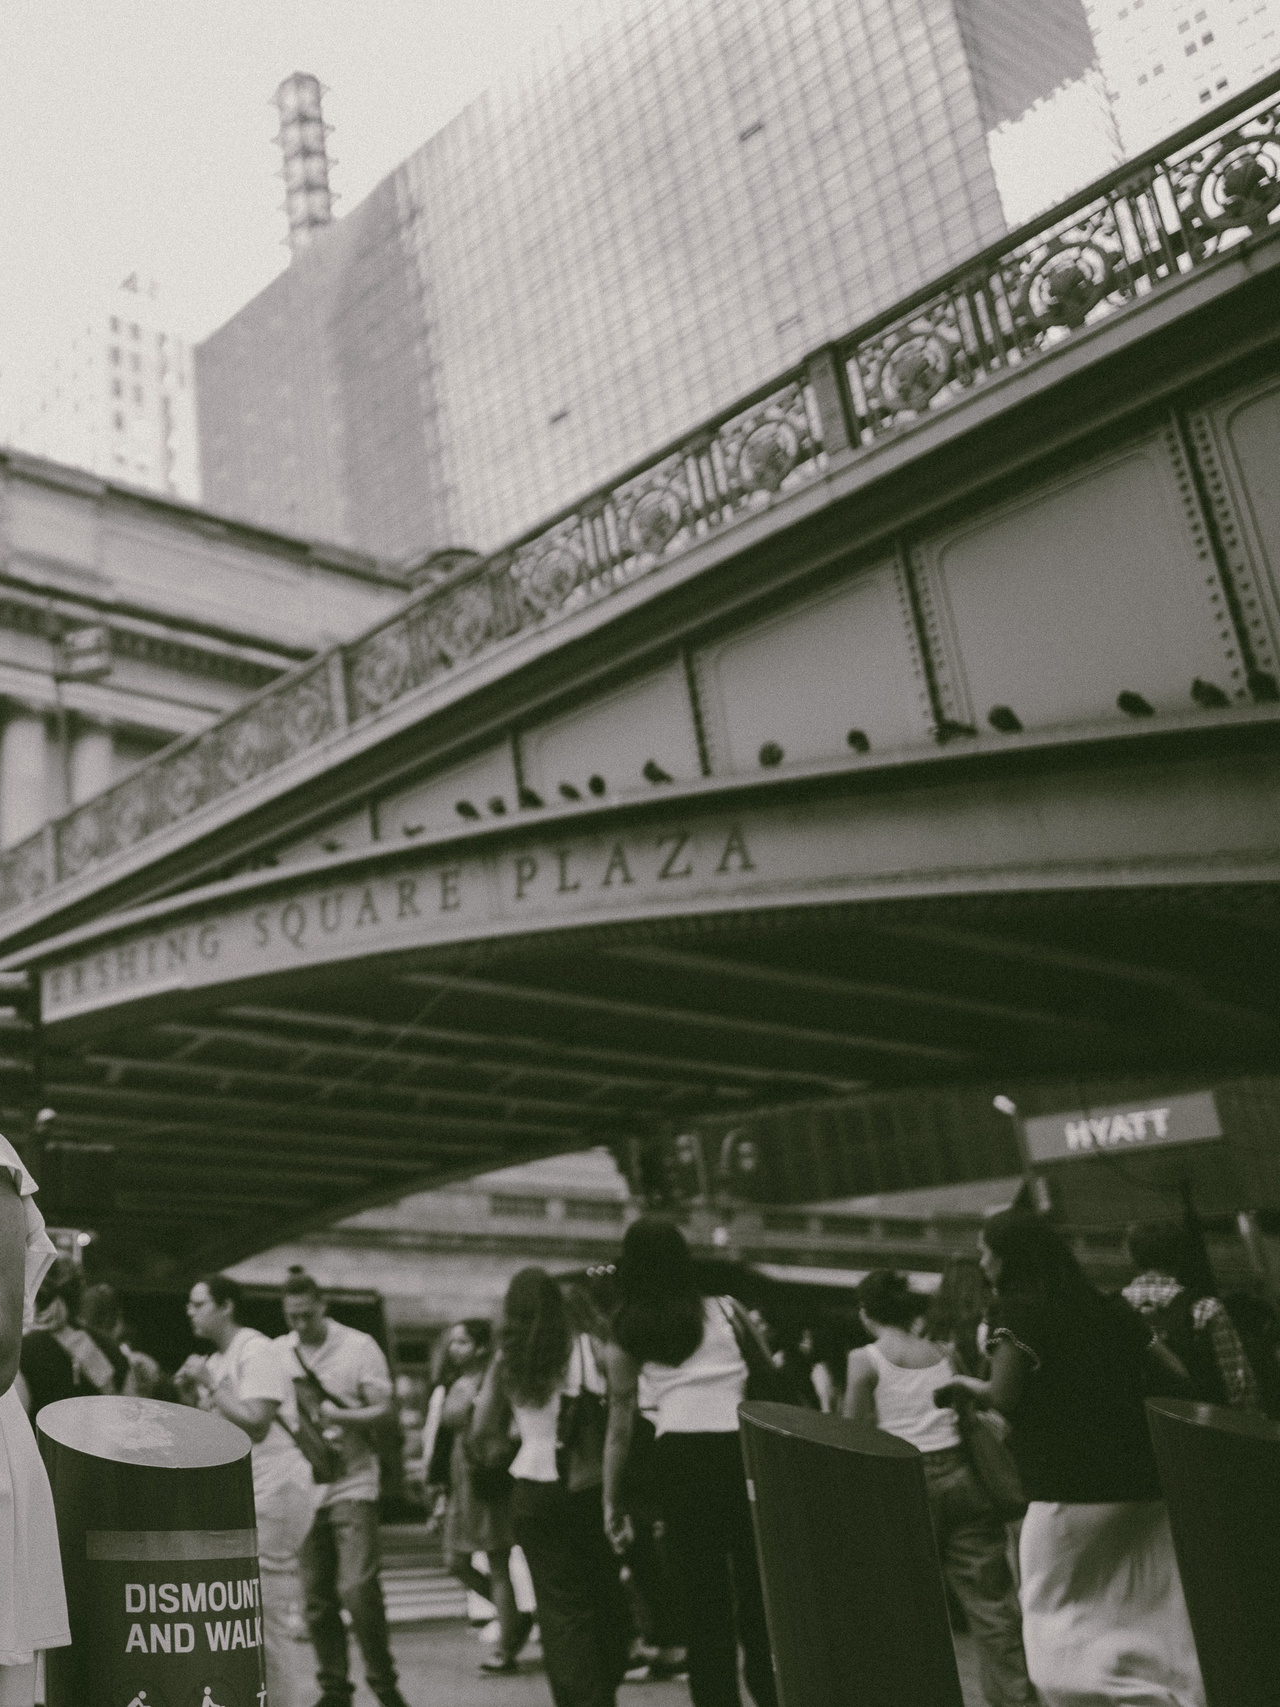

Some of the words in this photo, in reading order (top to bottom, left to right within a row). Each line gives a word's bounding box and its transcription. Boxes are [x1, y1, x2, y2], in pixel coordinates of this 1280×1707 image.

[49, 923, 220, 1003] SHING
[254, 867, 463, 952] SQUARE
[514, 824, 756, 899] PLAZA
[1064, 1108, 1170, 1150] HYATT
[124, 1578, 259, 1613] DISMOUNT
[125, 1623, 195, 1653] AND
[205, 1617, 263, 1652] WALK
